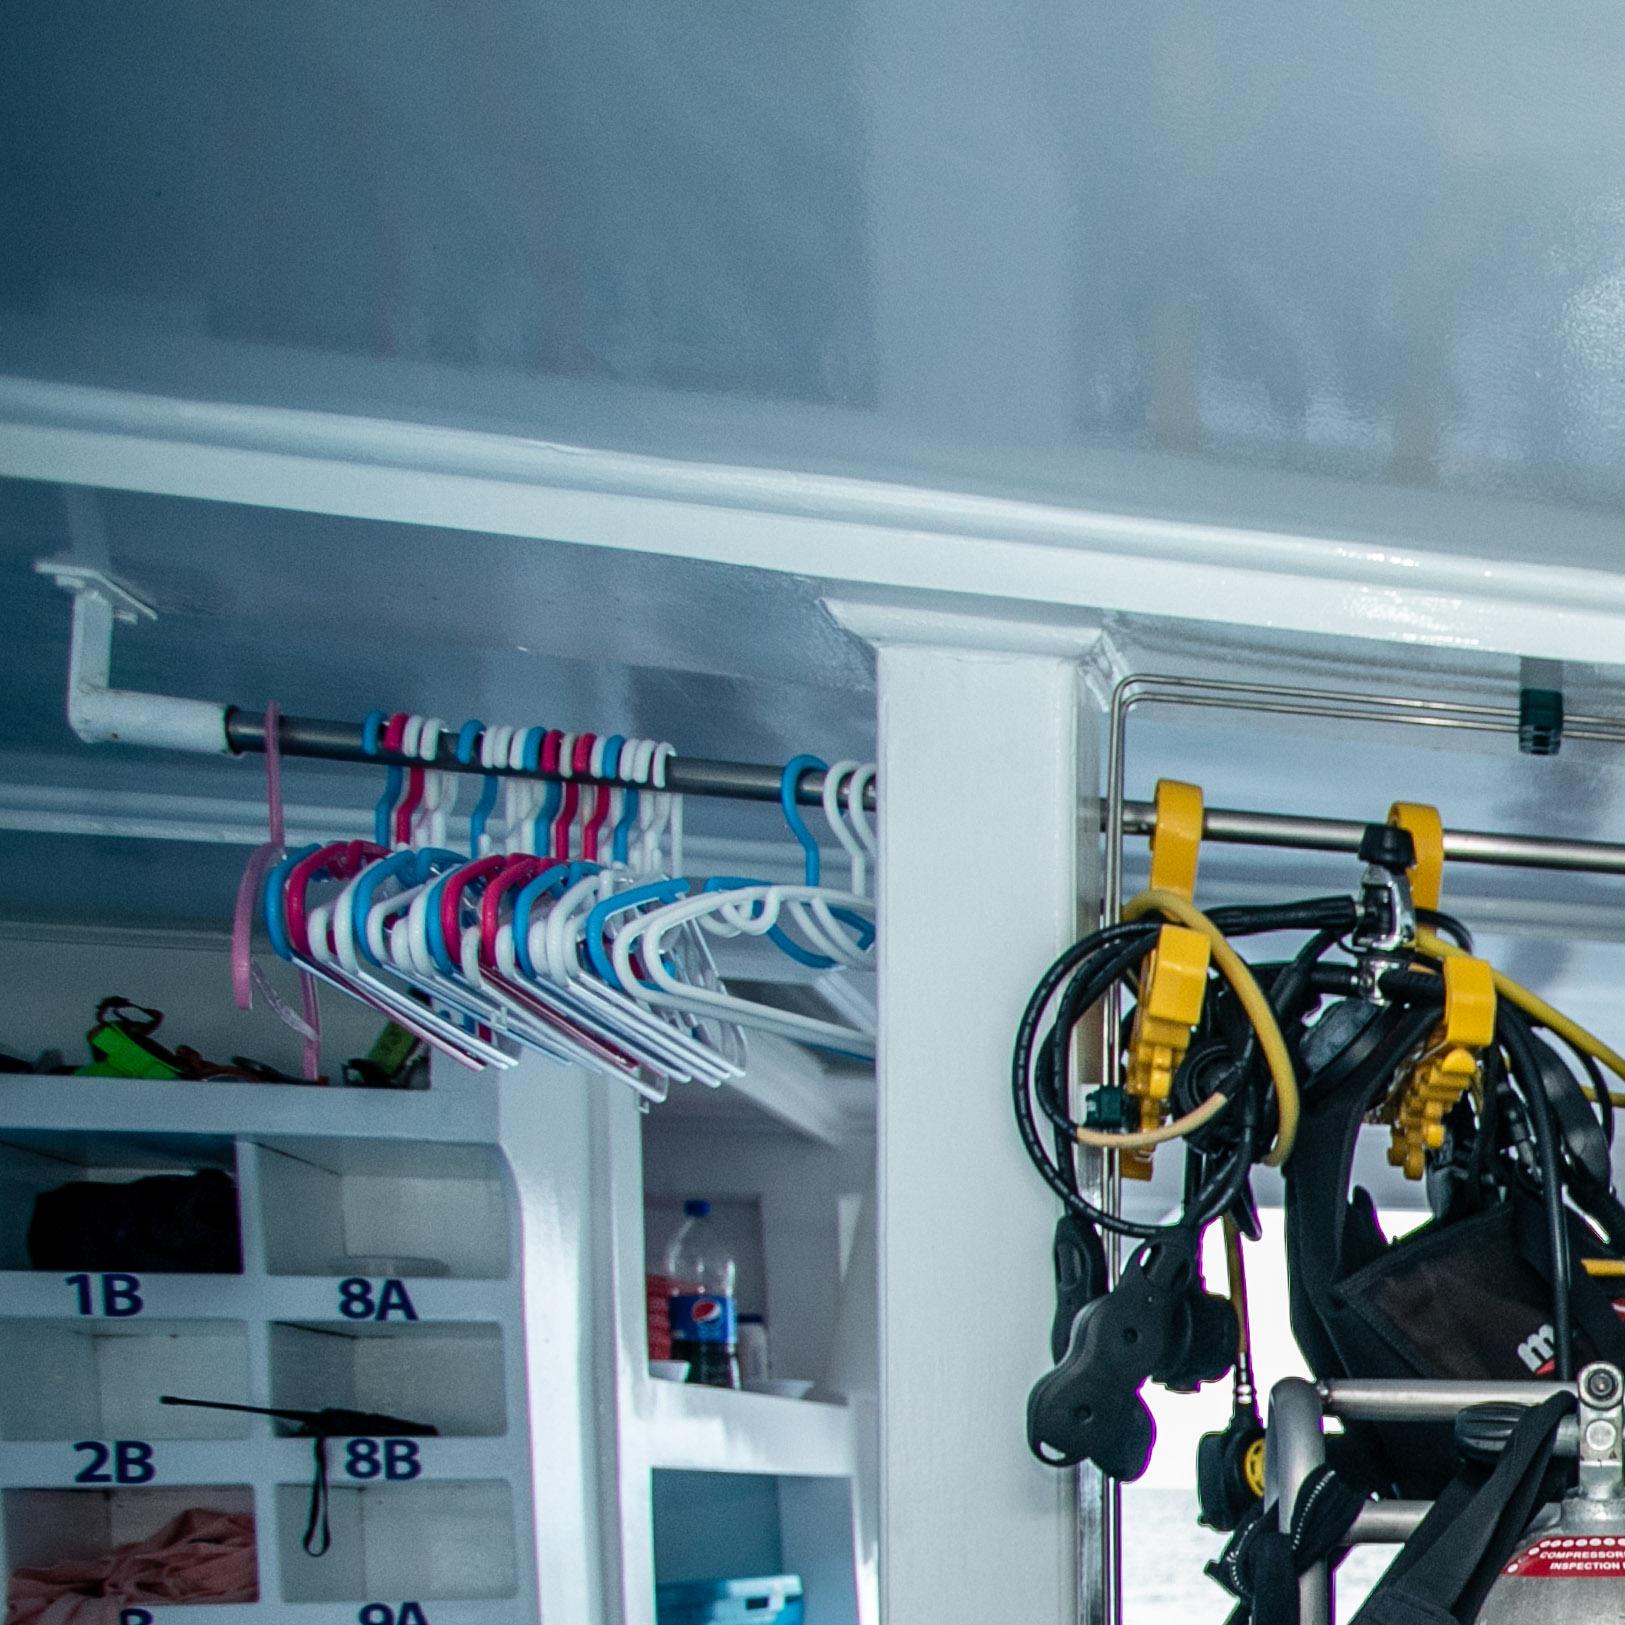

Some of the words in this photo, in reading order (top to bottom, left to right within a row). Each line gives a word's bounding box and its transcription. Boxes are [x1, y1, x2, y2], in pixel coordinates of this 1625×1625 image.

[65, 1273, 144, 1318] 1B
[338, 1277, 420, 1322] 8A
[72, 1439, 157, 1484] 2B
[344, 1437, 423, 1481] 8B
[1550, 1561, 1622, 1571] INSPECTION
